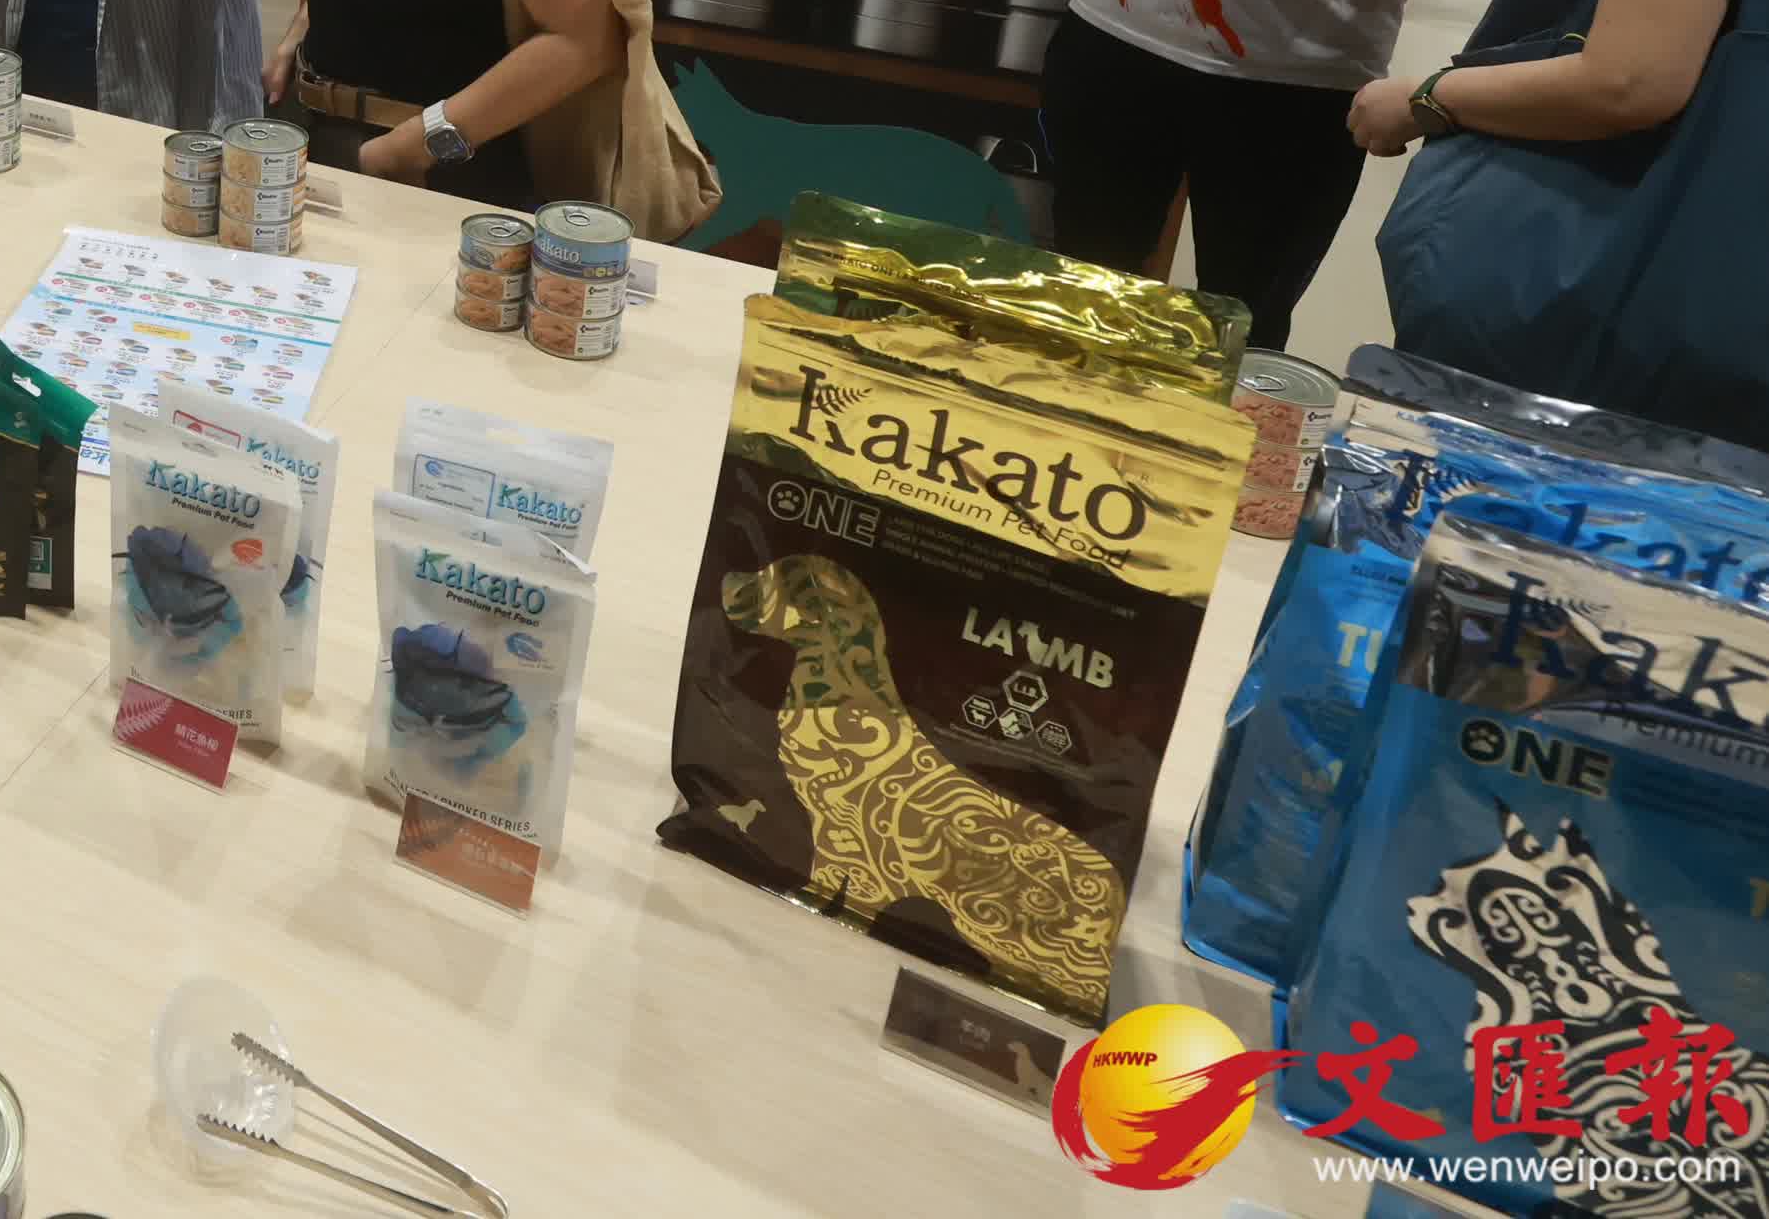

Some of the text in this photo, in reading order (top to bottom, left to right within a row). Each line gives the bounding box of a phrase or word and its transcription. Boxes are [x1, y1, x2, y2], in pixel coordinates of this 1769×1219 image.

[789, 363, 1149, 542] Kakato
[145, 458, 261, 519] Kakato
[495, 482, 583, 525] Kakato
[767, 480, 881, 548] ONE
[871, 468, 993, 522] Premium
[1001, 509, 1048, 540] Pet
[1051, 526, 1132, 571] Food
[415, 546, 547, 616] Kakato
[445, 590, 541, 628] Premium Pet Food
[961, 606, 1115, 689] LAMB
[1460, 718, 1612, 798] ONE
